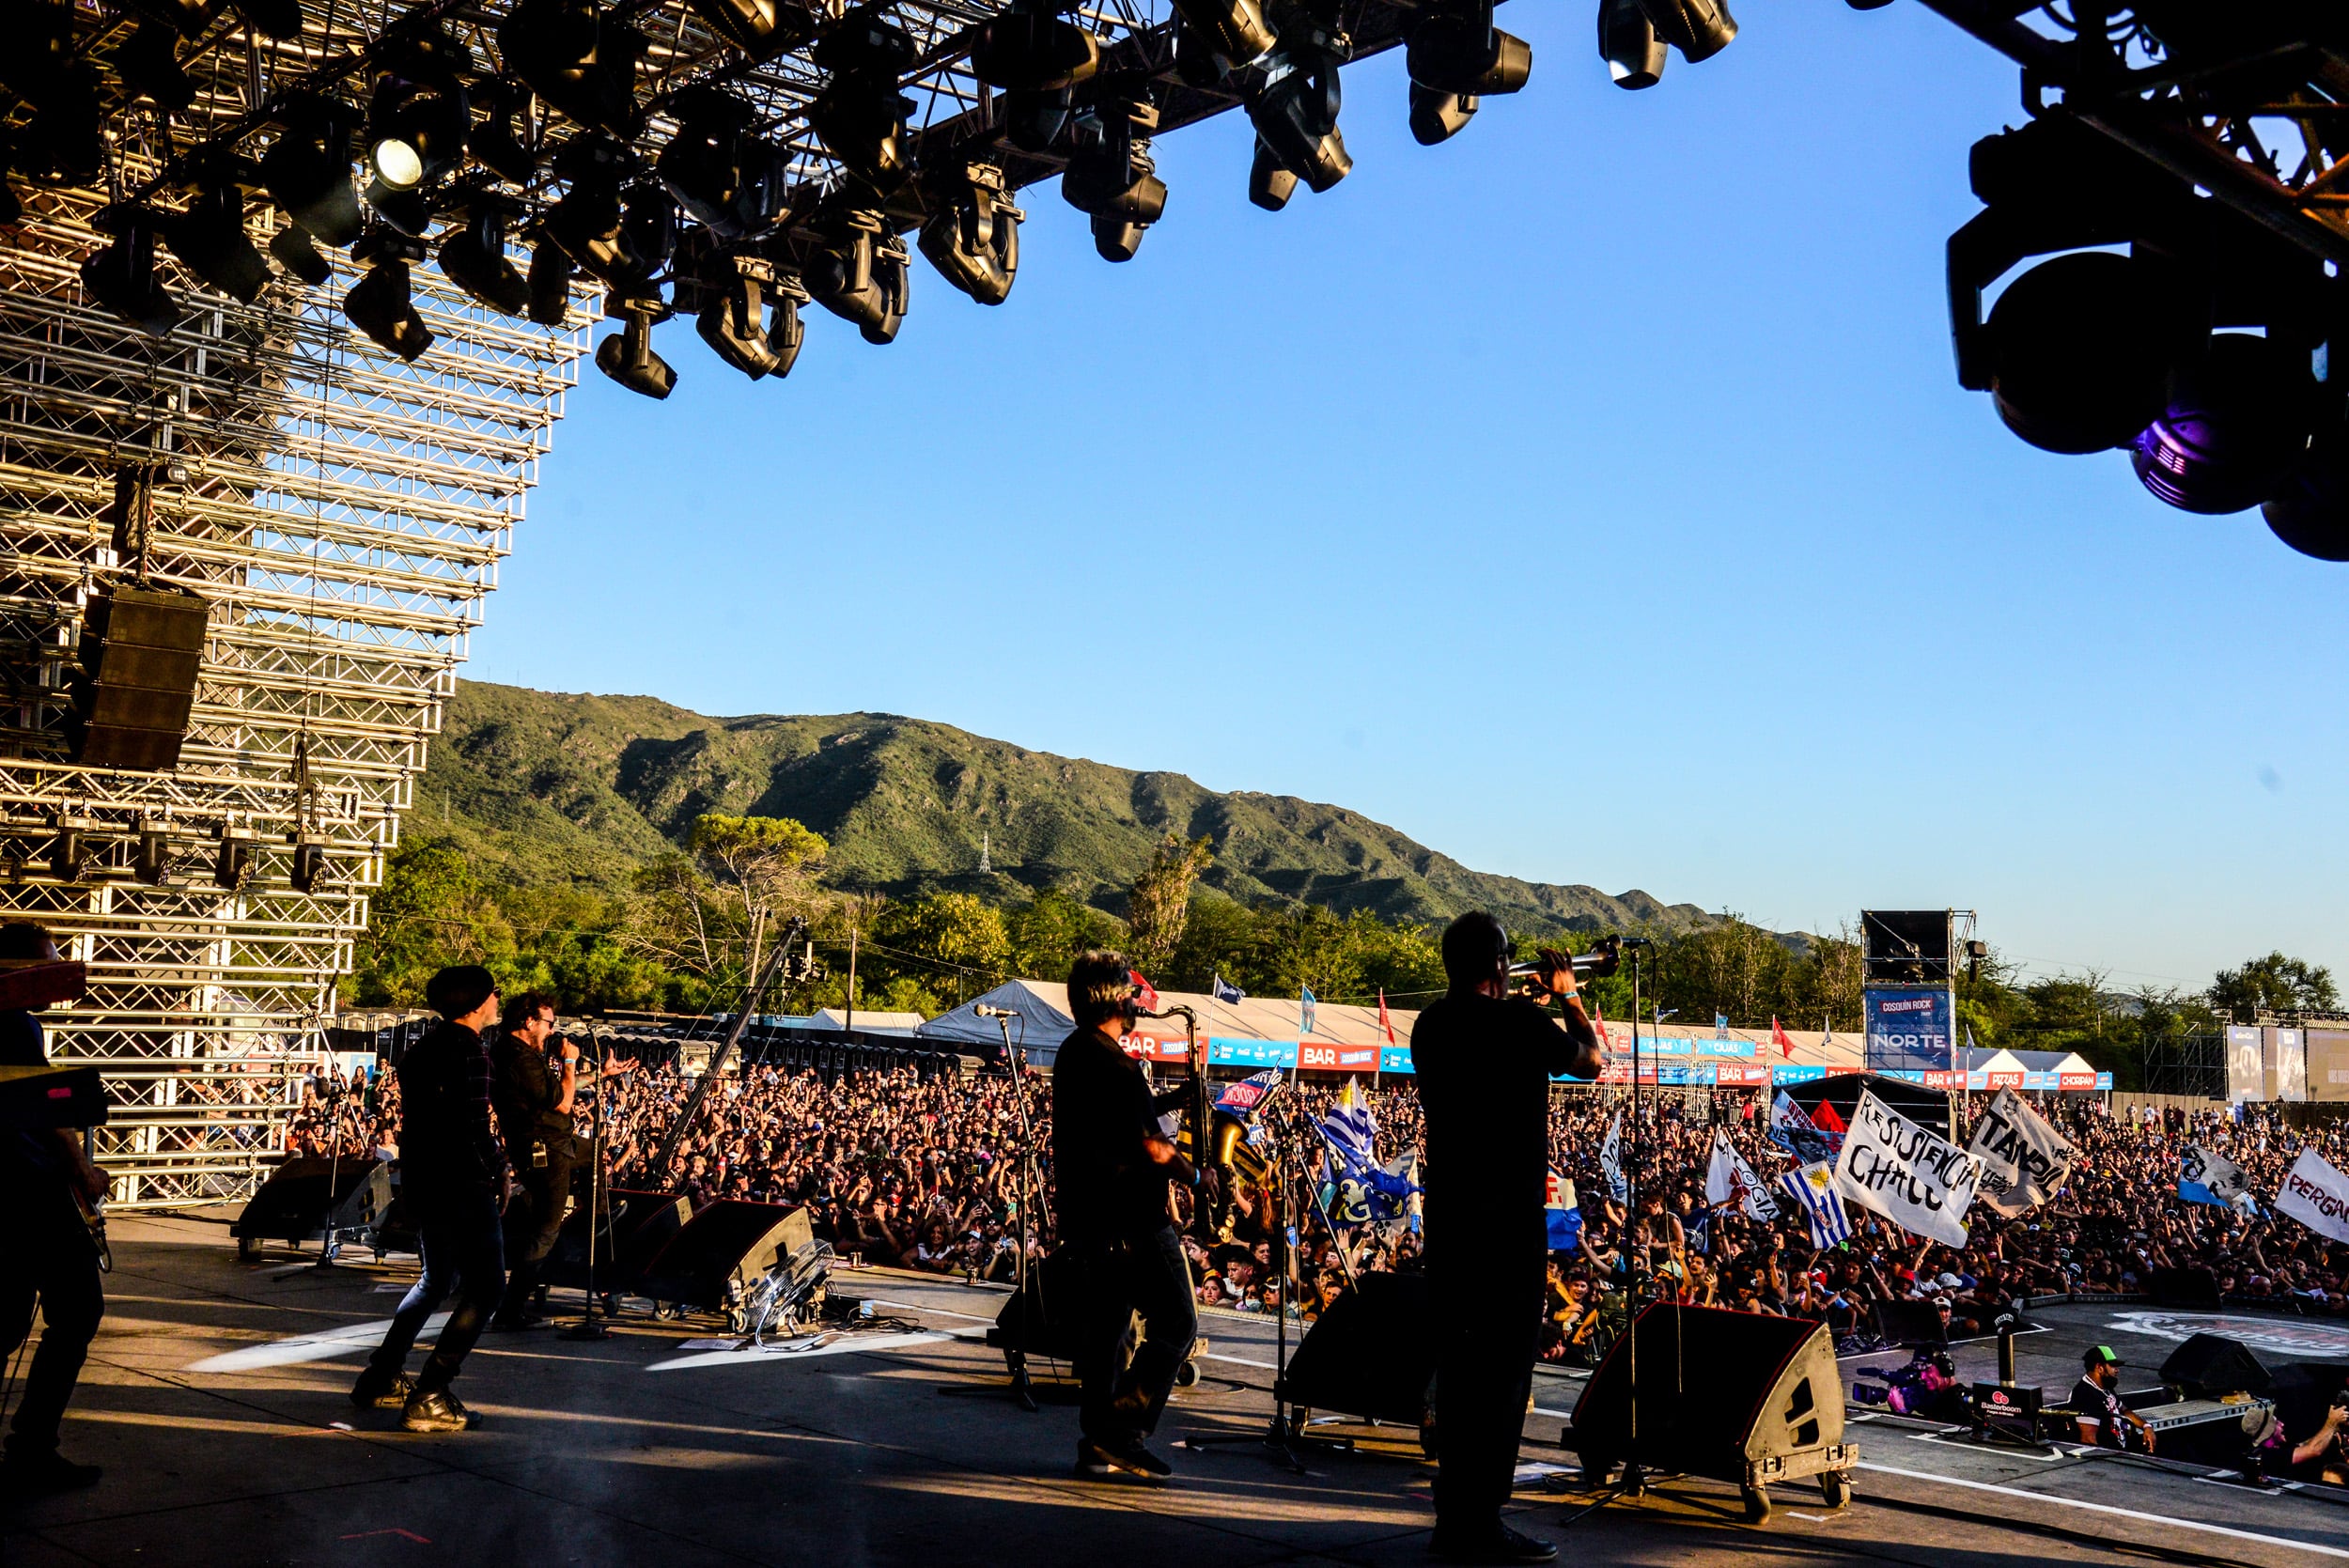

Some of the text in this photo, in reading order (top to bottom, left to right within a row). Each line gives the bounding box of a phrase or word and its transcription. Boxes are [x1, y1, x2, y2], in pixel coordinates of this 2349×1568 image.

[1912, 1000, 1931, 1010] ROCK
[1118, 1036, 1156, 1054] BAR
[1874, 1033, 1946, 1048] NORTE
[1713, 1042, 1738, 1053] CAJAS
[1303, 1048, 1335, 1065] BAR
[1719, 1067, 1742, 1080] BAR
[1927, 1073, 1944, 1085] BAR
[1992, 1074, 2019, 1085] PIZZAS
[2061, 1075, 2094, 1086] CHORIPÁN
[1860, 1095, 1981, 1192] RESISTENCIA
[1981, 1110, 2065, 1198] TANDIL
[1981, 1402, 2022, 1413] Basterboom
